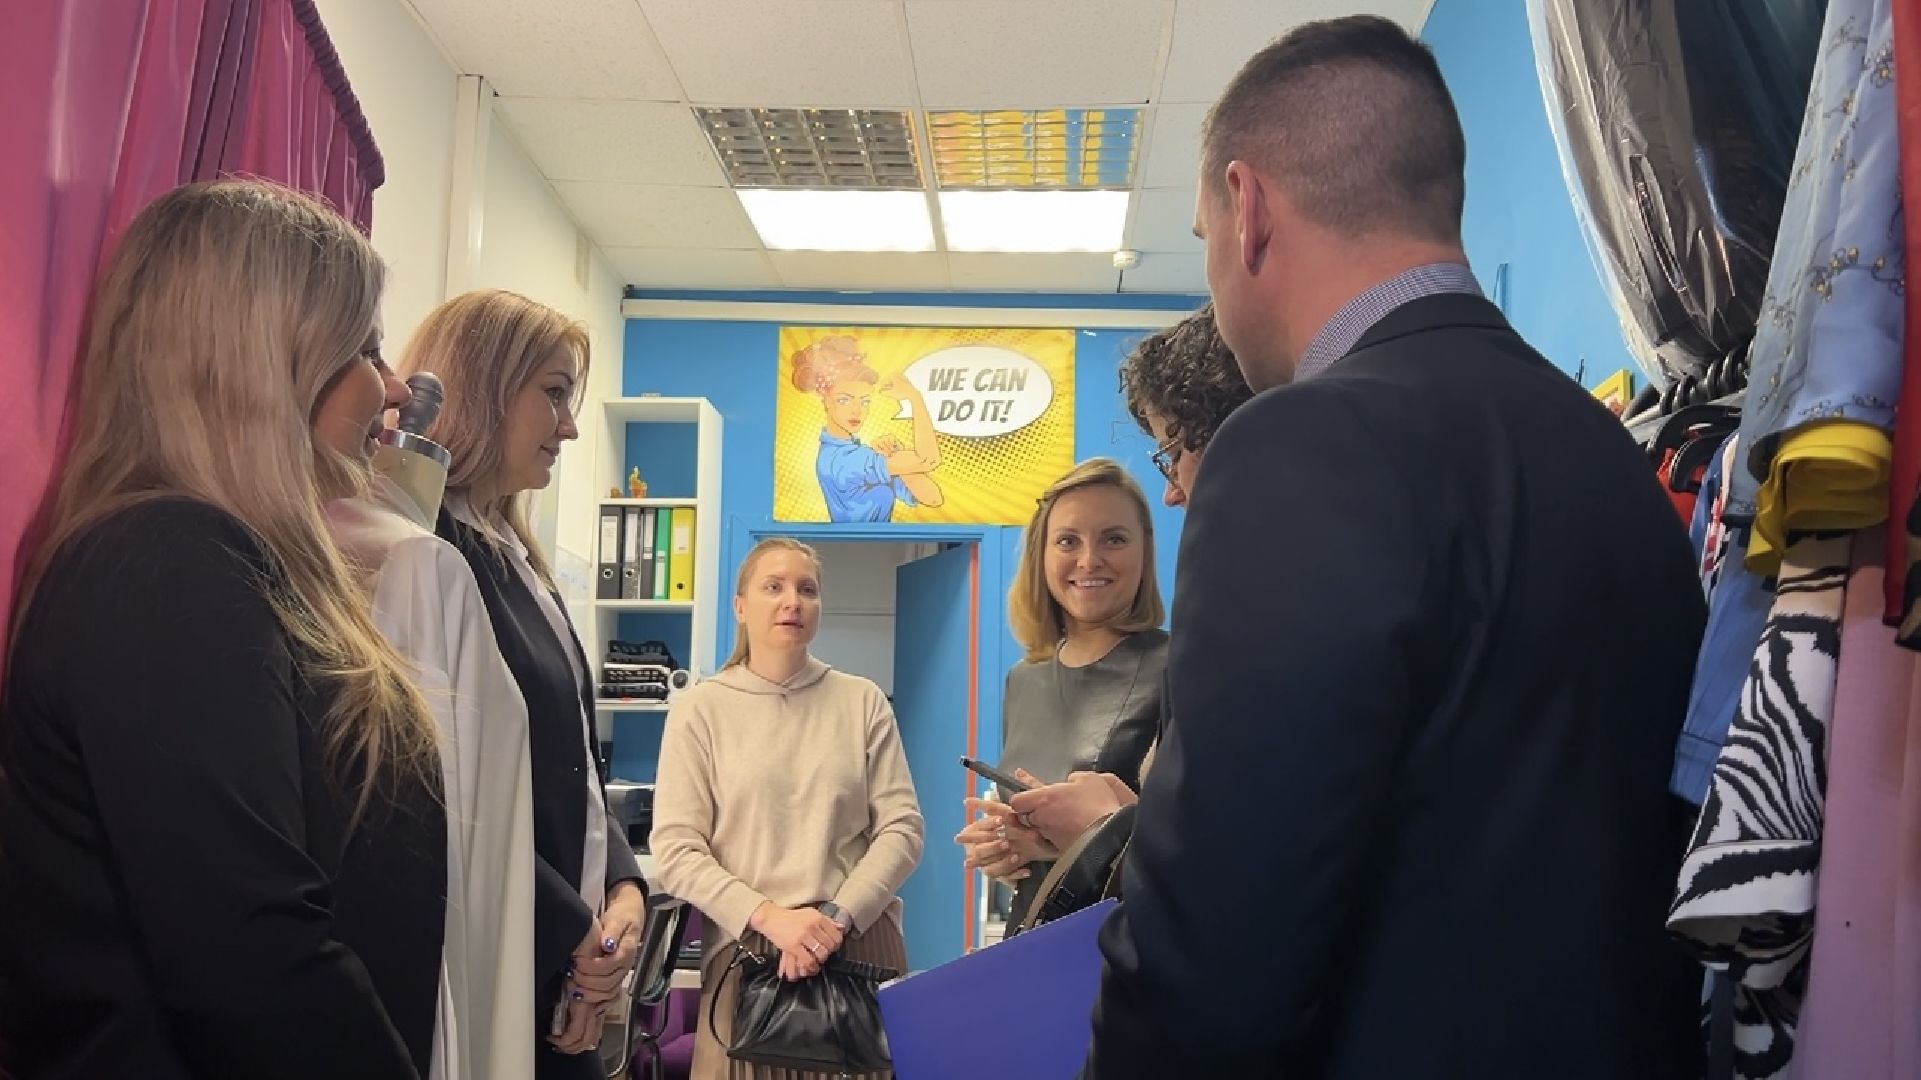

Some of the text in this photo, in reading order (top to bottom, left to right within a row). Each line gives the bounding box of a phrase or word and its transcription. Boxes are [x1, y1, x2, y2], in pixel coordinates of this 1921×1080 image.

[928, 368, 1029, 392] WE CAN
[938, 399, 1015, 423] DO IT!
